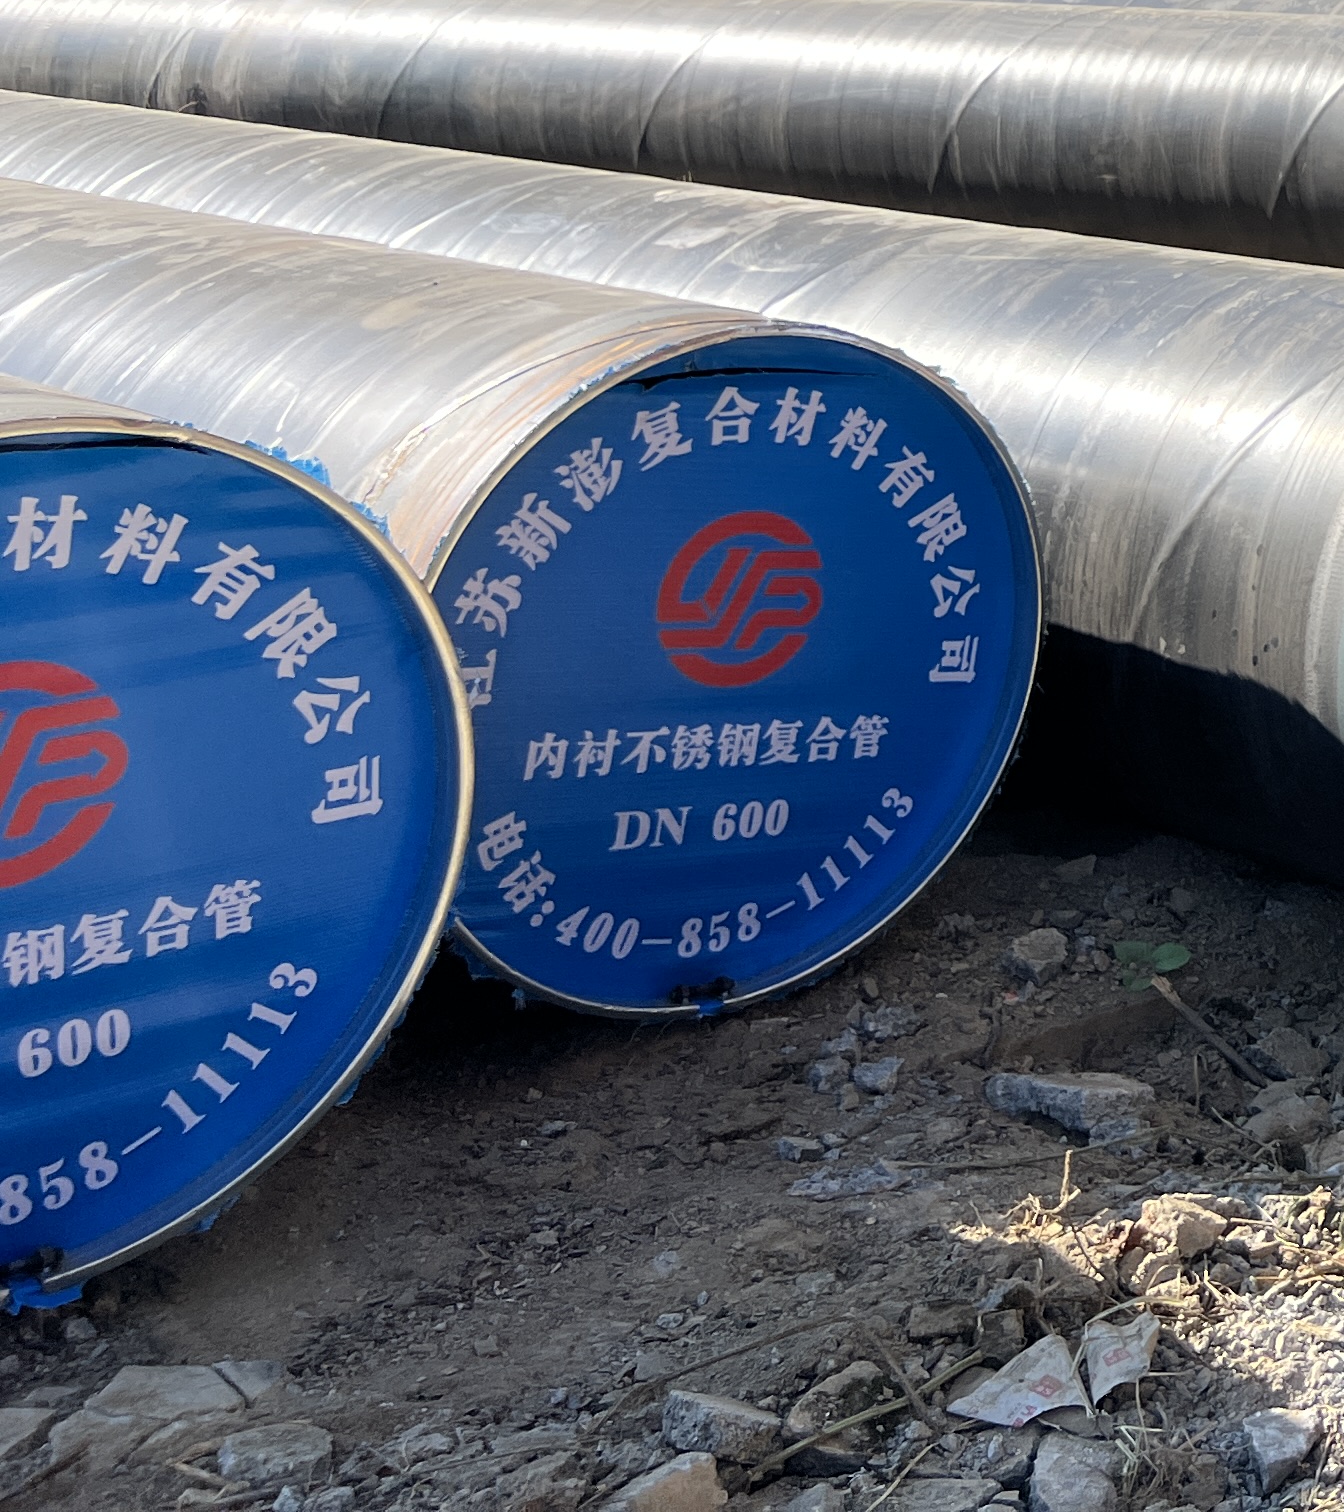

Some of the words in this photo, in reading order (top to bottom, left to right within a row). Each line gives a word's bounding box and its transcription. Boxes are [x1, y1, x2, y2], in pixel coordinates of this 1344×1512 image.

[4, 495, 384, 825] 材料有限公司
[523, 714, 890, 781] 内衬不锈钢复合管
[609, 806, 693, 852] DN
[712, 799, 790, 842] 600
[1, 879, 262, 988] 钢复合管
[17, 1008, 132, 1078] 600
[0, 962, 318, 1225] 858-11113
